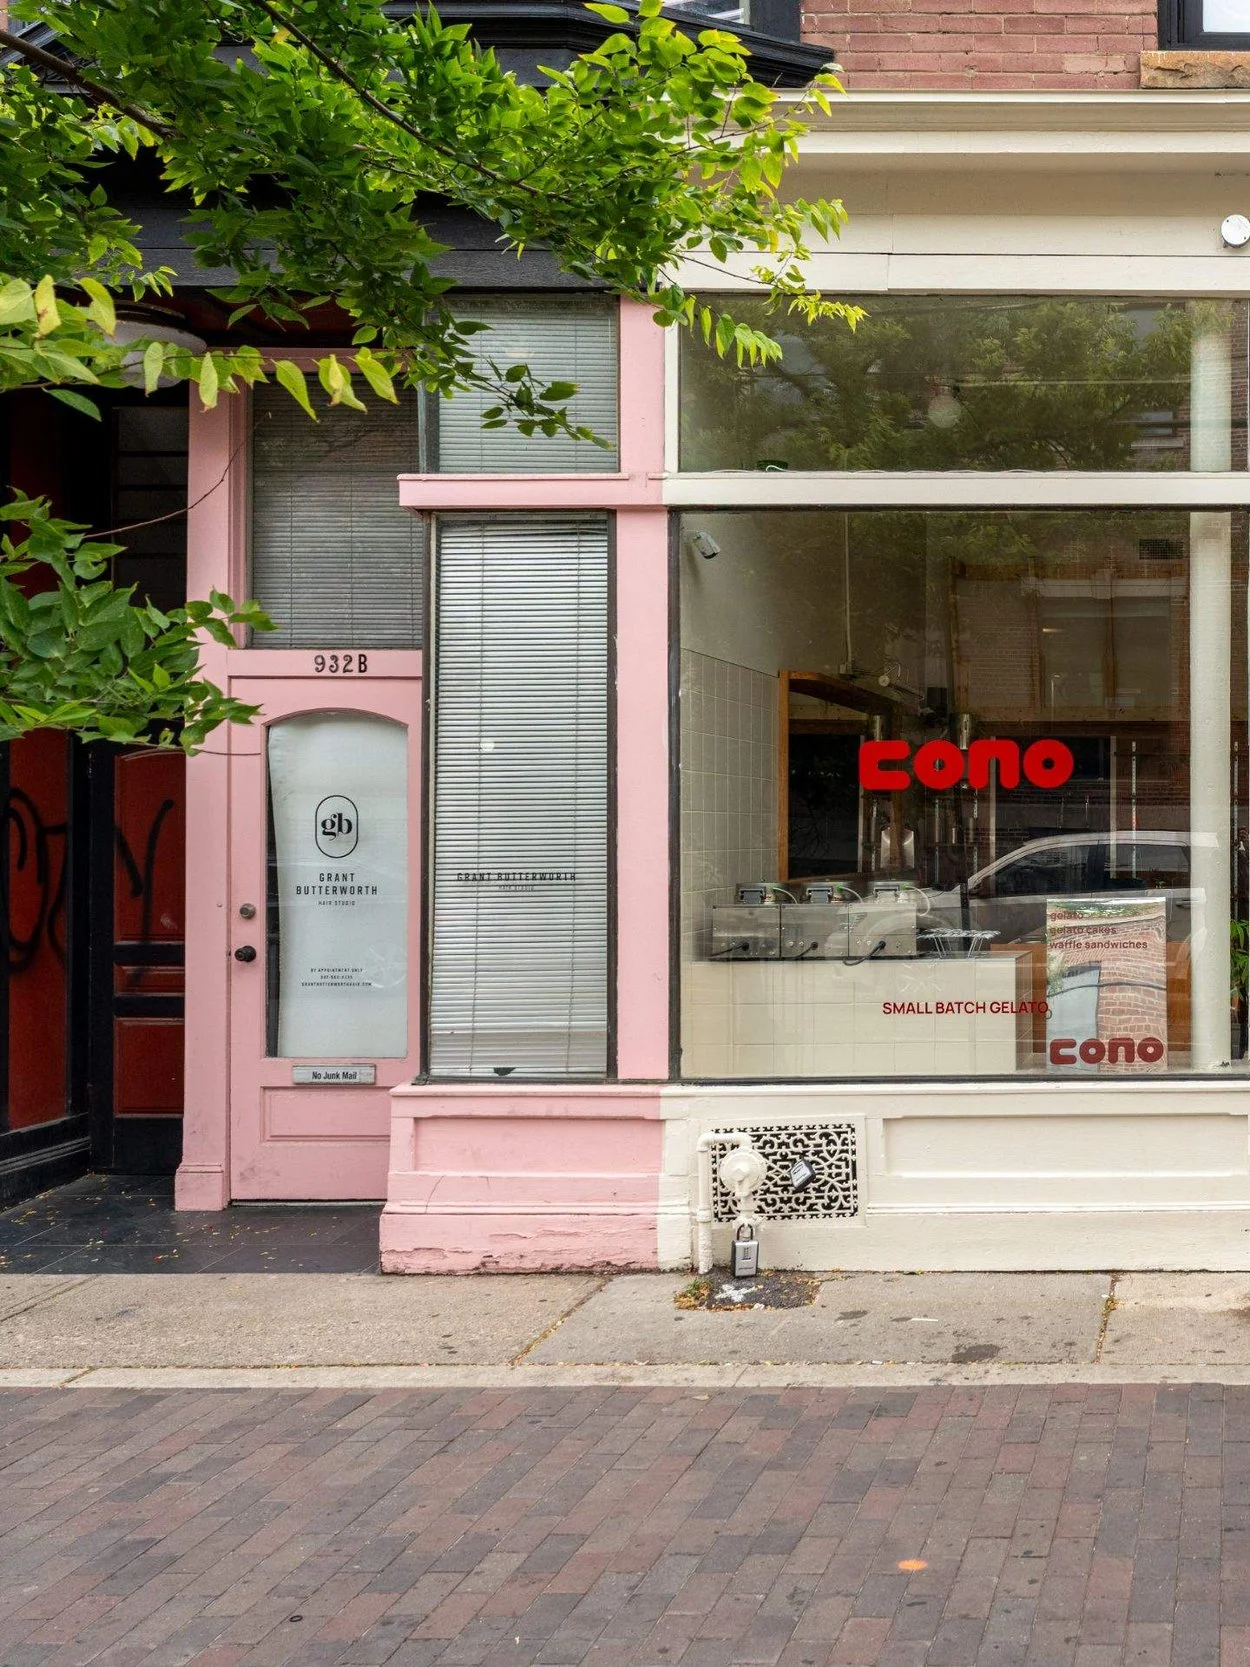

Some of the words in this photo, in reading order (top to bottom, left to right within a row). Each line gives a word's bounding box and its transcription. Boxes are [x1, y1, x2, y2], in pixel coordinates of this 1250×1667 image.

[859, 739, 1074, 790] cono
[319, 872, 355, 882] GRANT
[457, 872, 491, 881] GRANT
[497, 871, 576, 881] BUTTERWORTH
[296, 885, 378, 895] BUTTERWORTH
[1050, 910, 1084, 919] gelato
[1050, 926, 1085, 936] gelato
[1086, 926, 1118, 934] cakes
[1050, 940, 1083, 949] waffle
[1084, 940, 1148, 949] sandwiches
[883, 1002, 932, 1014] SMALL
[936, 1002, 986, 1014] BATCH
[990, 1001, 1049, 1014] GELATO
[1050, 1037, 1164, 1064] cono
